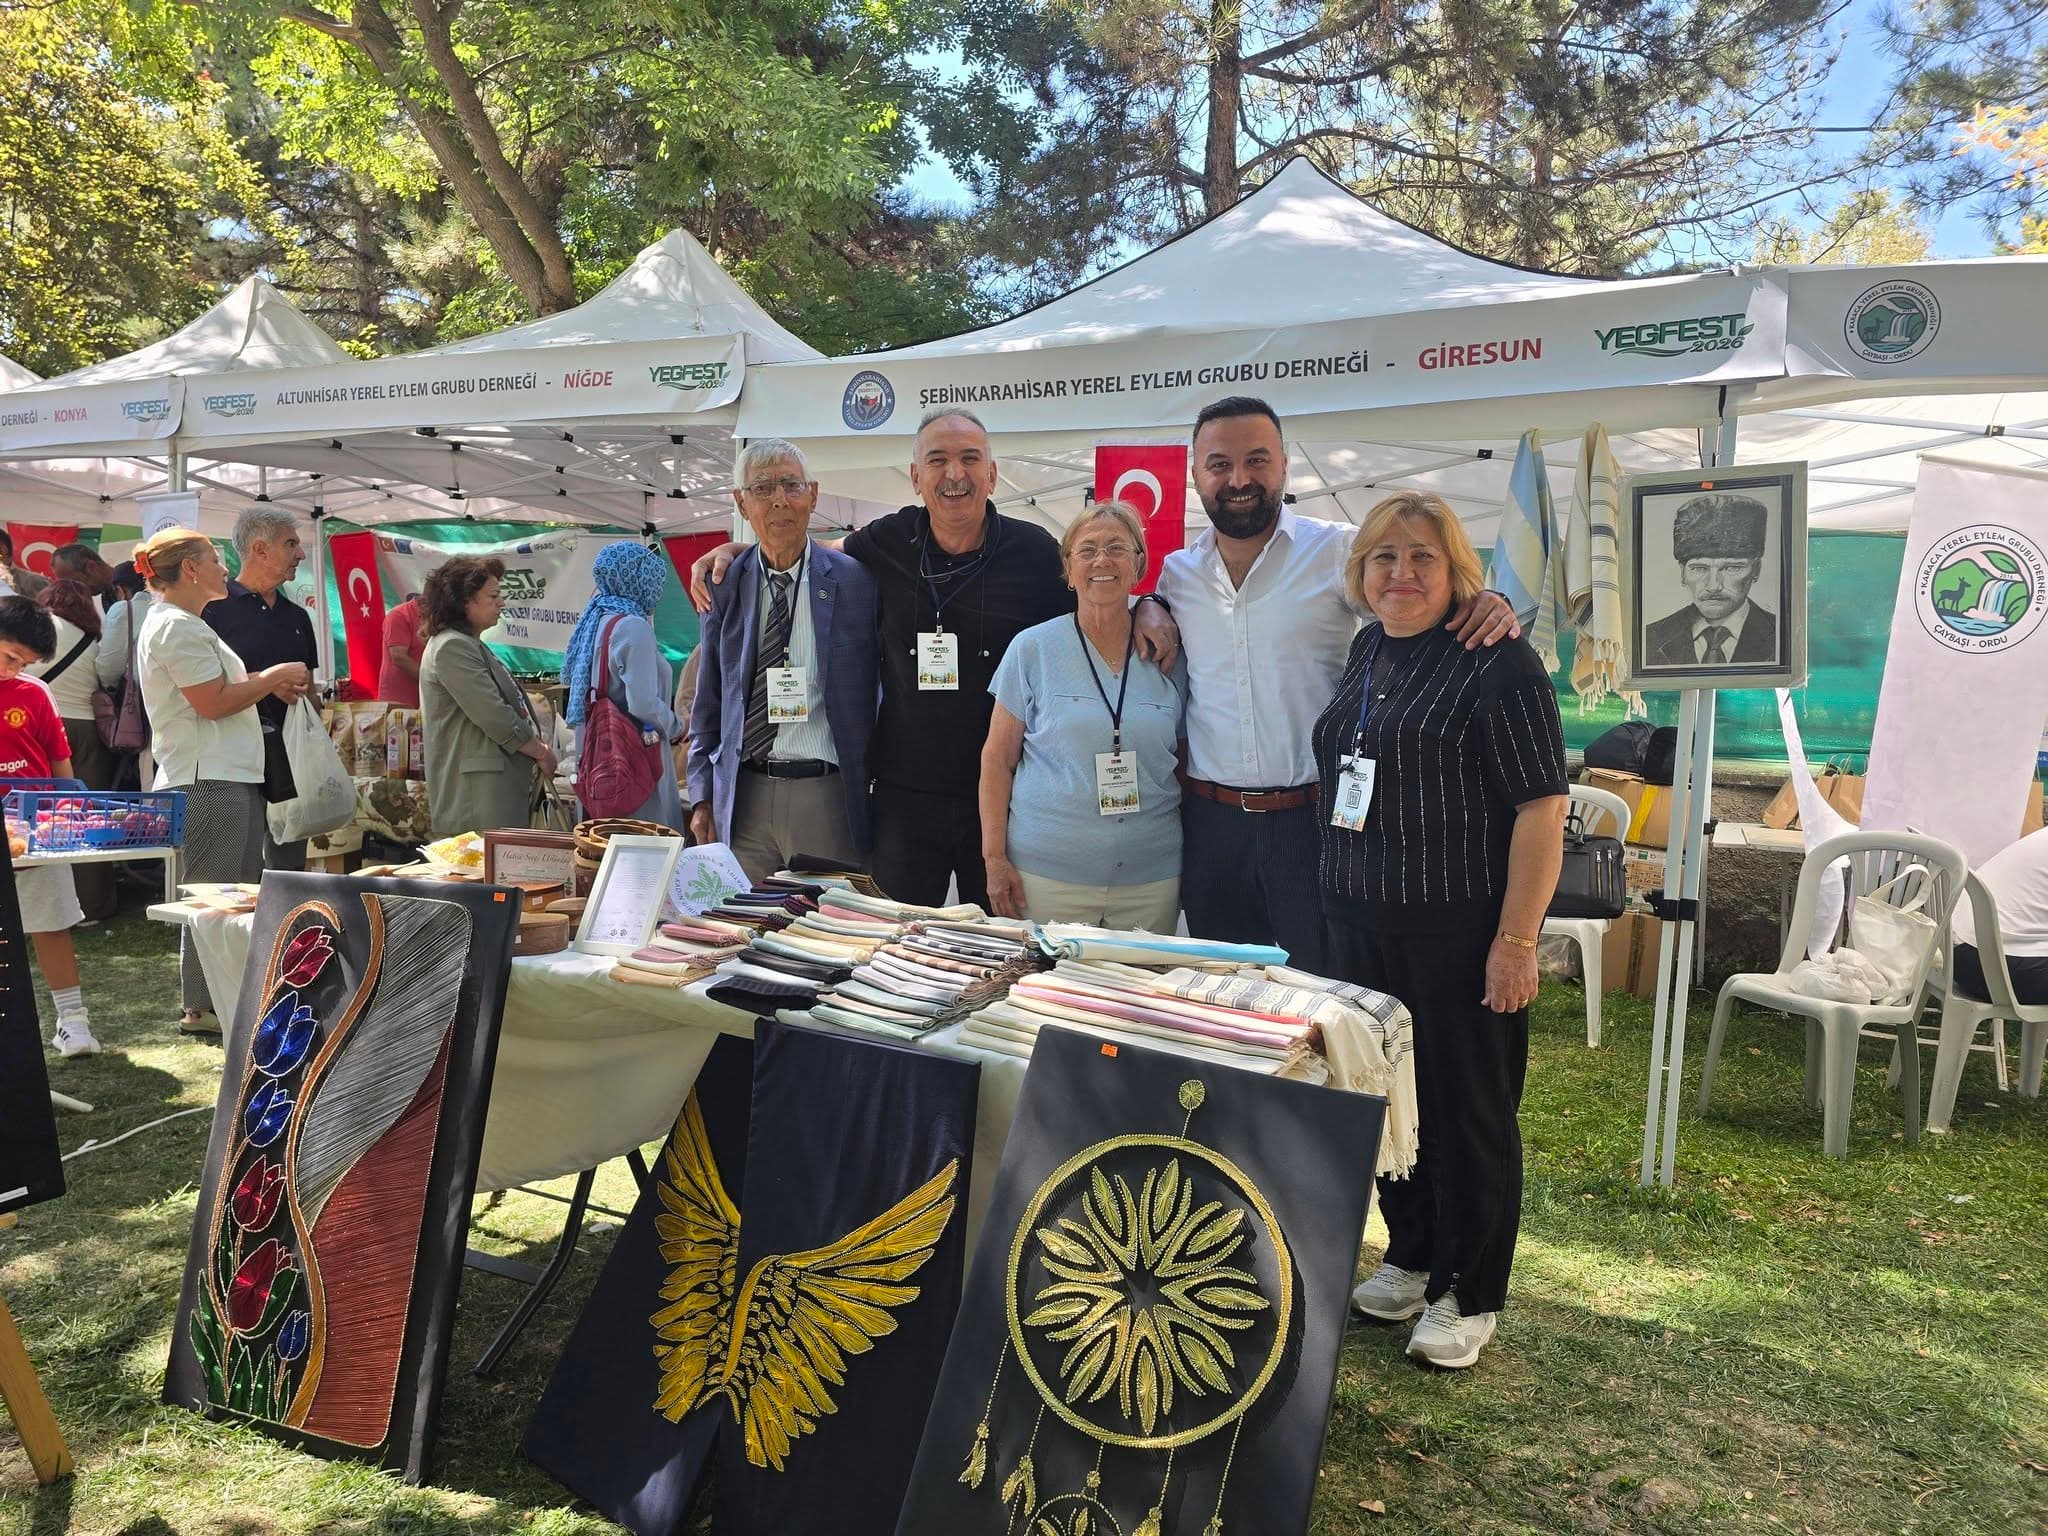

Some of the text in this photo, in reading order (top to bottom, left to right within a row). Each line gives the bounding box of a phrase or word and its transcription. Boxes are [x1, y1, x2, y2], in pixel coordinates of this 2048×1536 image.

[1594, 313, 1746, 350] YEGFEST
[1690, 337, 1745, 353] 2026
[649, 363, 728, 382] YEGFEST
[919, 379, 1067, 408] ŞEBİNKARAHİSAR
[1070, 376, 1125, 395] YEREL
[1130, 370, 1192, 391] EYLEM
[1198, 362, 1268, 384] GRUBU
[1275, 350, 1368, 379] DERNEĞİ
[1418, 338, 1542, 370] GİRESUN
[276, 387, 347, 405] ALTUNHİSAR
[350, 385, 386, 400] YEREL
[389, 382, 428, 398] EYLEM
[431, 379, 475, 395] GRUBU
[479, 372, 537, 392] DERNEĞİ
[563, 369, 614, 389] NİĞDE
[121, 399, 169, 415] YEGFEST
[202, 394, 255, 410] YEGFEST
[54, 408, 88, 422] KONYA
[235, 408, 255, 416] 2026
[1921, 553, 1942, 588] KARACA
[1941, 535, 1971, 553] YEREL
[1974, 531, 2005, 541] EYLEM
[2008, 537, 2037, 563] GRUBU
[507, 588, 545, 600] 2026
[531, 607, 555, 623] GRUBU
[506, 623, 529, 638] KONYA
[1933, 624, 1970, 648] ÇAYBAŞI
[1979, 635, 2008, 648] ORDU
